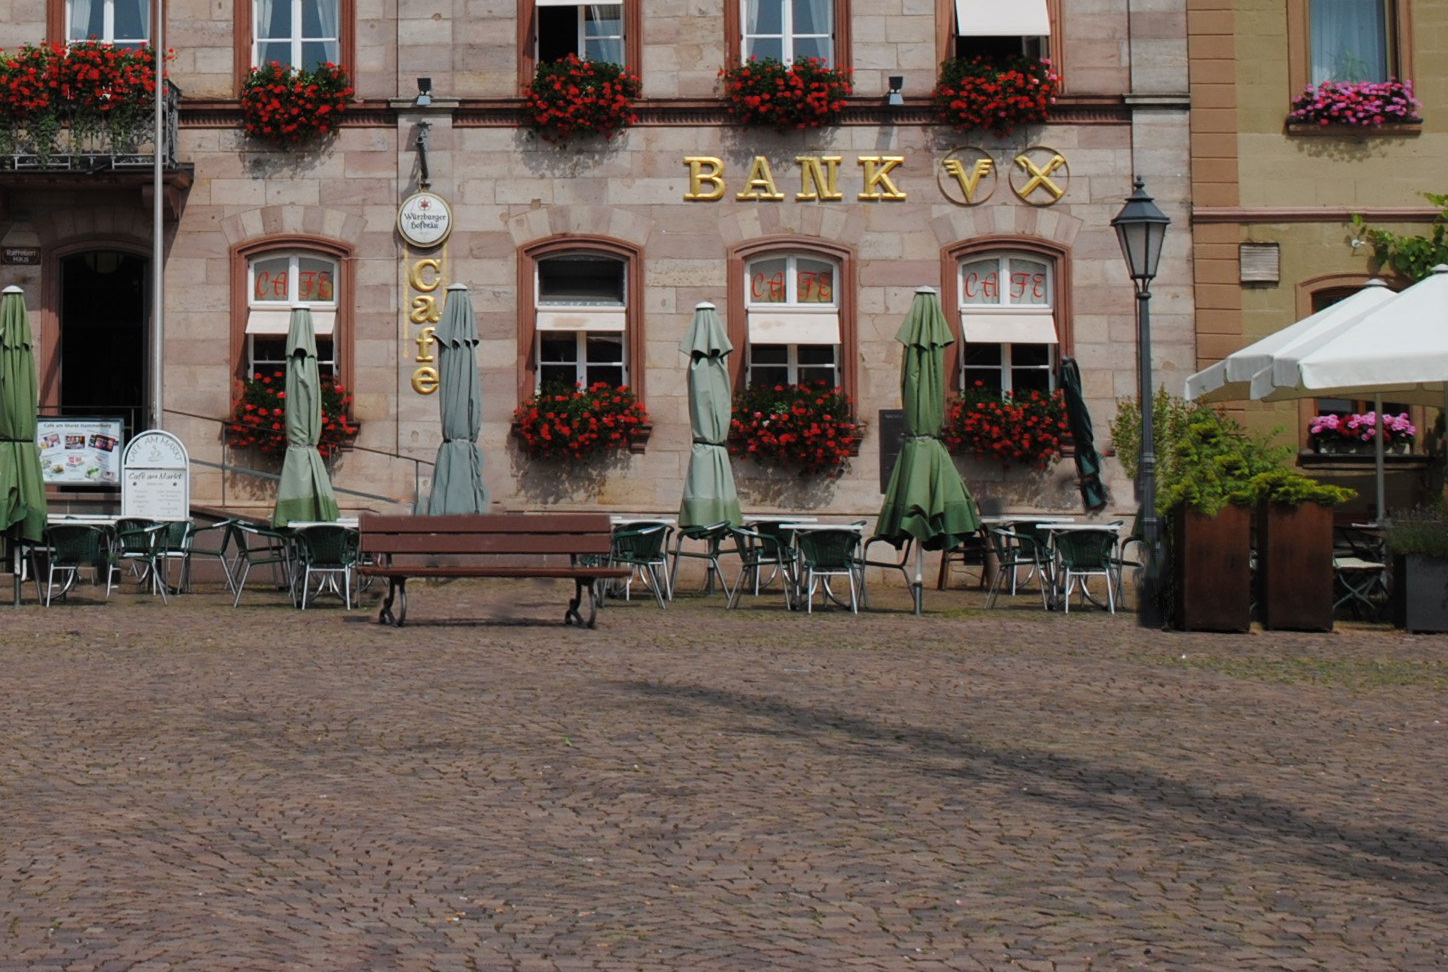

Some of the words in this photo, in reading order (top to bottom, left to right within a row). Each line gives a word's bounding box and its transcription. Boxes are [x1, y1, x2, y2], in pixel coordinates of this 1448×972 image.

[682, 155, 908, 202] BANK
[404, 212, 446, 222] Würzburger
[409, 258, 442, 396] Cafe
